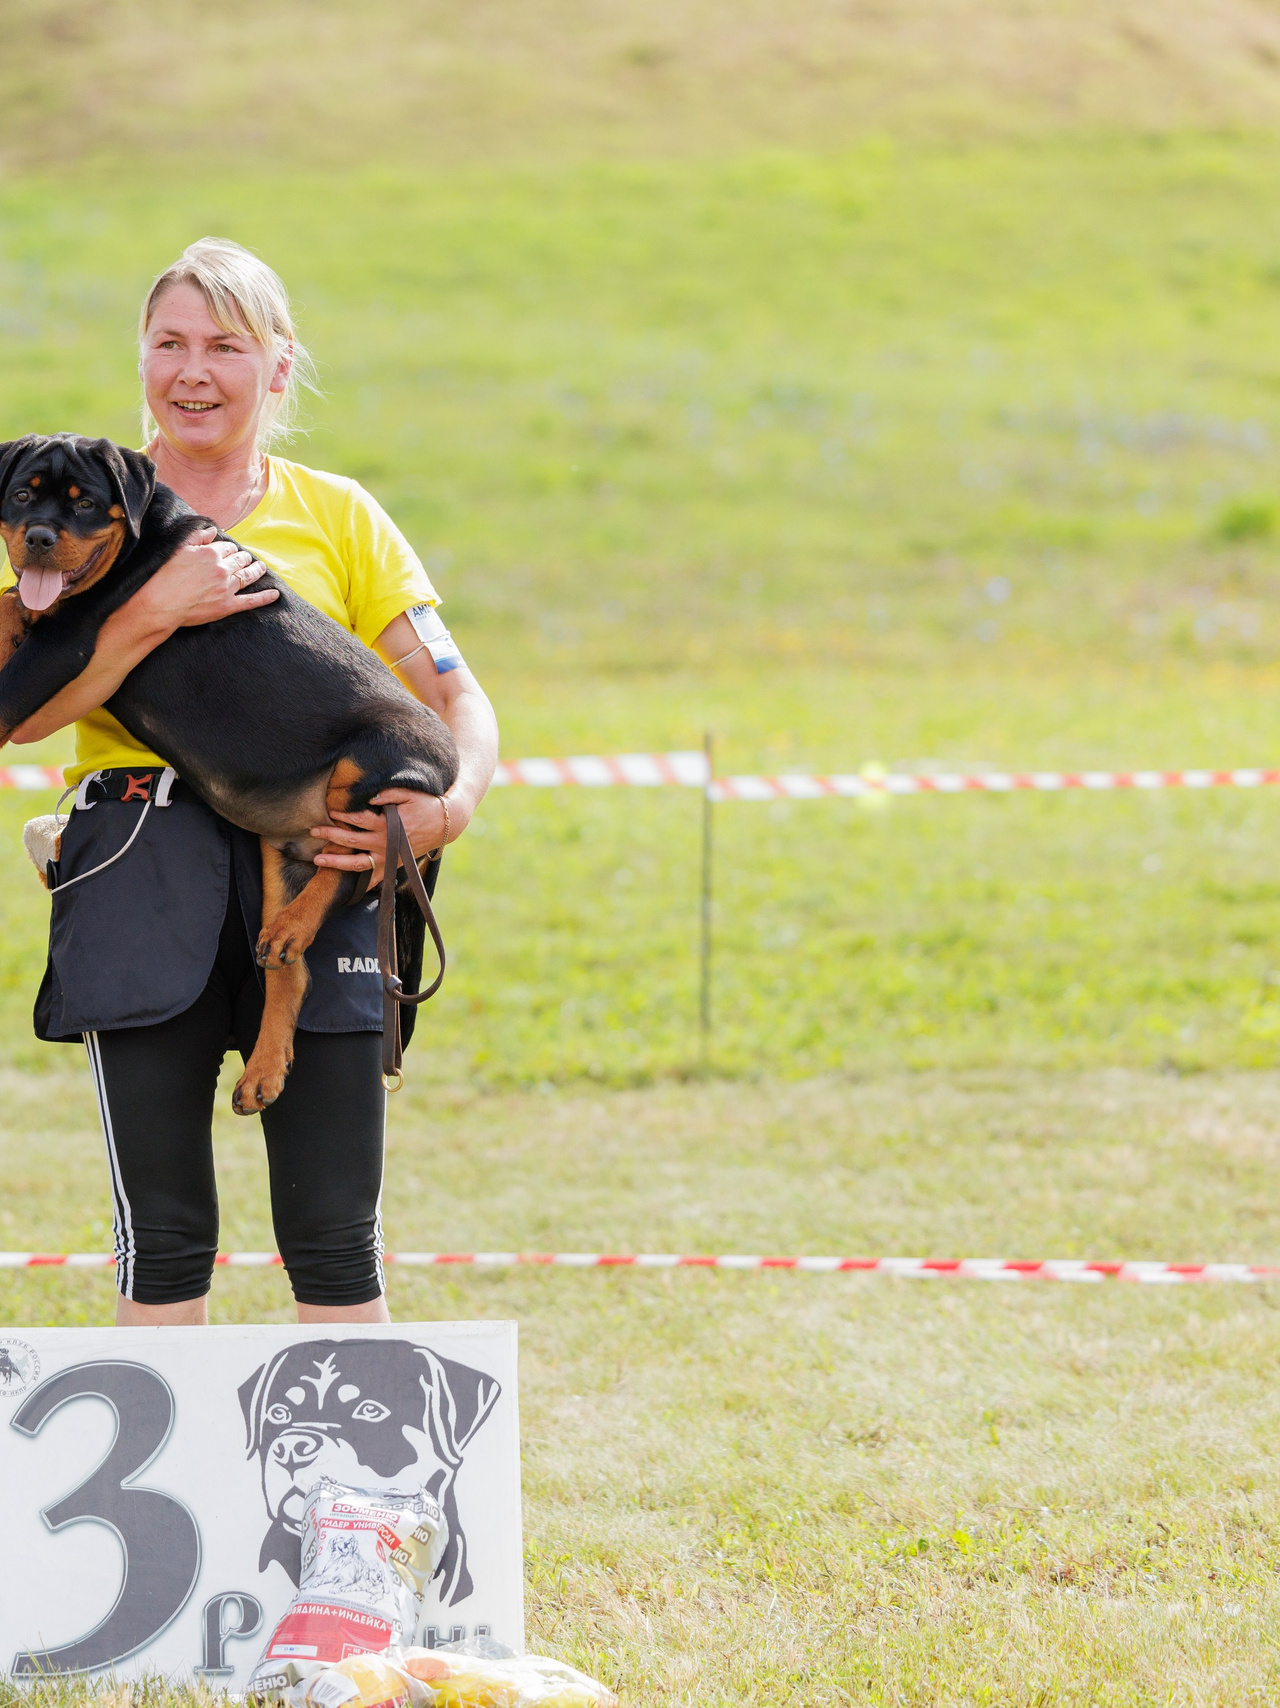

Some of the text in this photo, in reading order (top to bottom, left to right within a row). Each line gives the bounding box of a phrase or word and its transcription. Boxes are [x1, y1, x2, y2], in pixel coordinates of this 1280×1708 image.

[9, 1359, 203, 1678] 3
[333, 1504, 400, 1522] ЗООМЕНЮ
[320, 1519, 350, 1528] РИДЕР
[353, 1521, 396, 1545] УНИВЕРСАЛ
[291, 1604, 387, 1631] ВЯДИНА+ИНДЕЙКА
